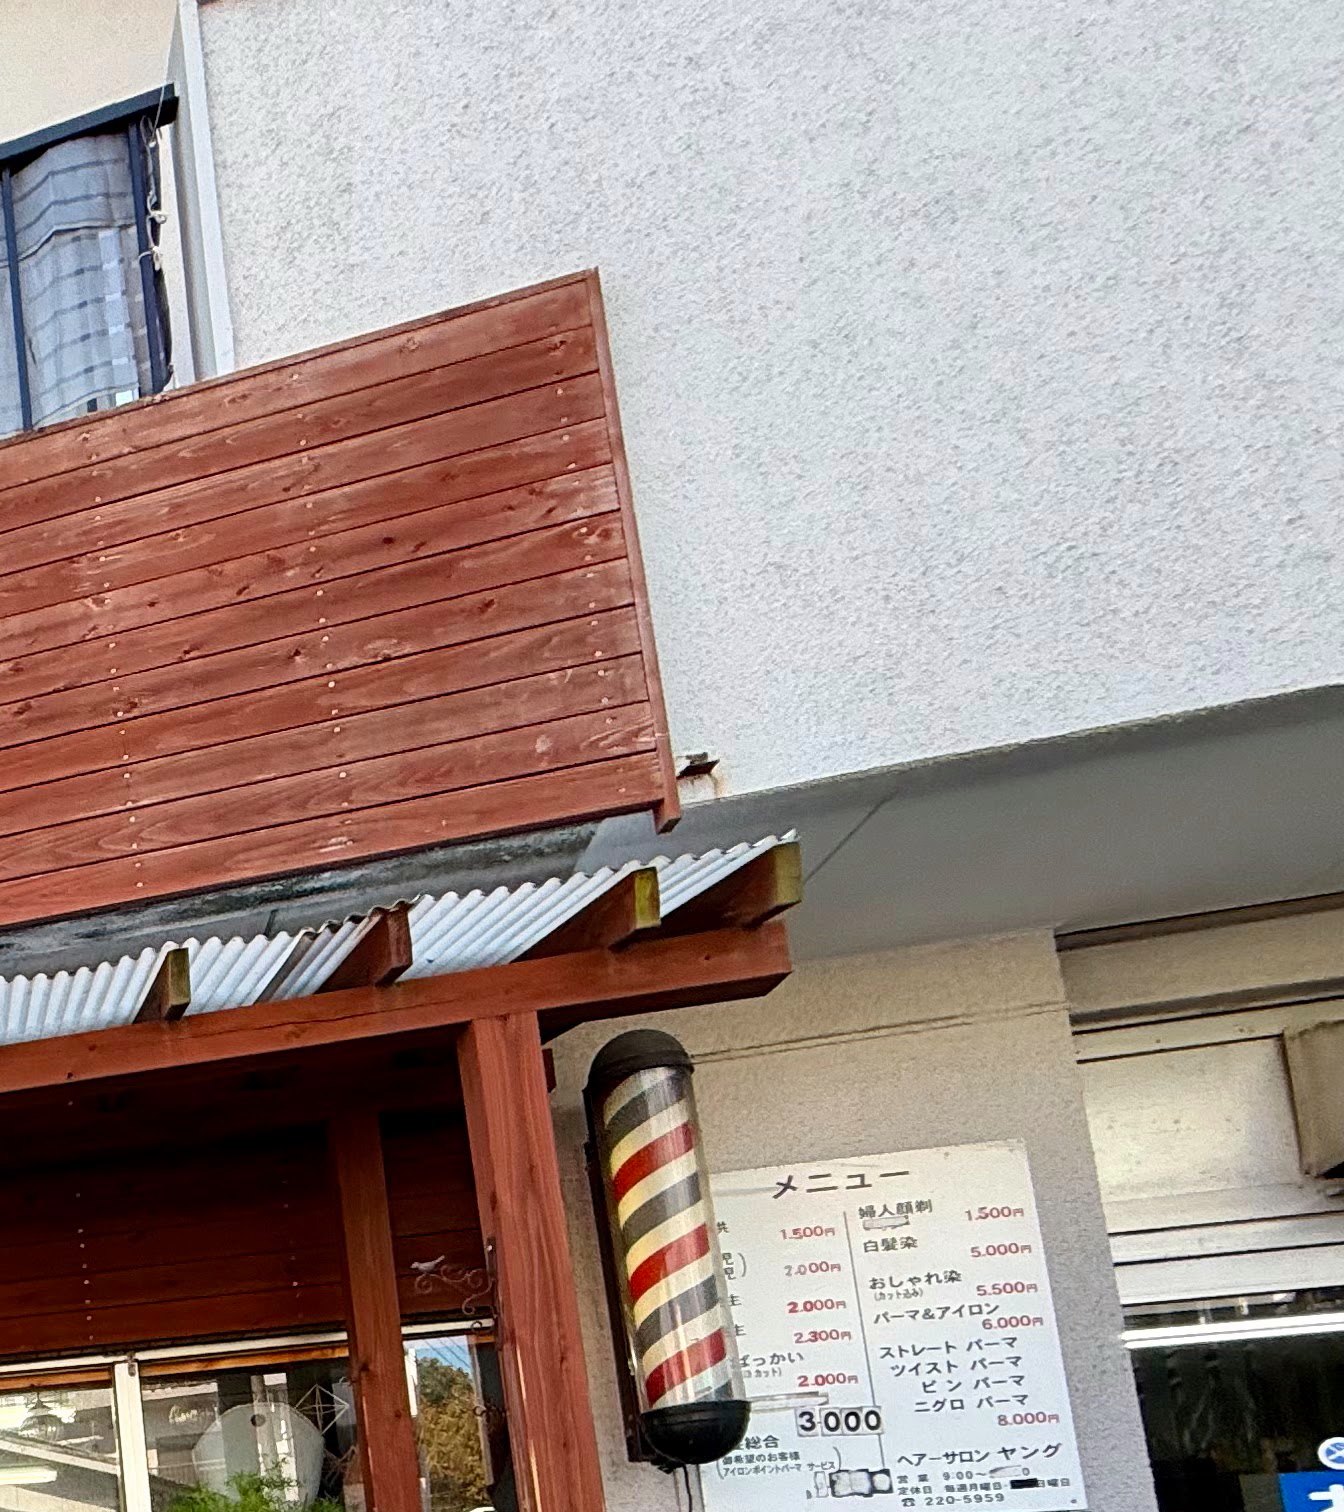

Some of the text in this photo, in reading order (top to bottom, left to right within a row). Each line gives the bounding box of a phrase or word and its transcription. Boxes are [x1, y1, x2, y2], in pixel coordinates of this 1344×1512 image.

[773, 1169, 911, 1200] メニュー
[970, 1243, 1032, 1258] 5.000円
[869, 1269, 1038, 1297] おしゃれ染 5.500円
[981, 1315, 1044, 1331] 6.000円
[879, 1340, 958, 1360] ストレート
[889, 1360, 959, 1378] ツイスト
[913, 1397, 965, 1413] ニグロ
[897, 1442, 1063, 1467] ヘアーサロン ヤング
[924, 1493, 1005, 1507] 220-5959
